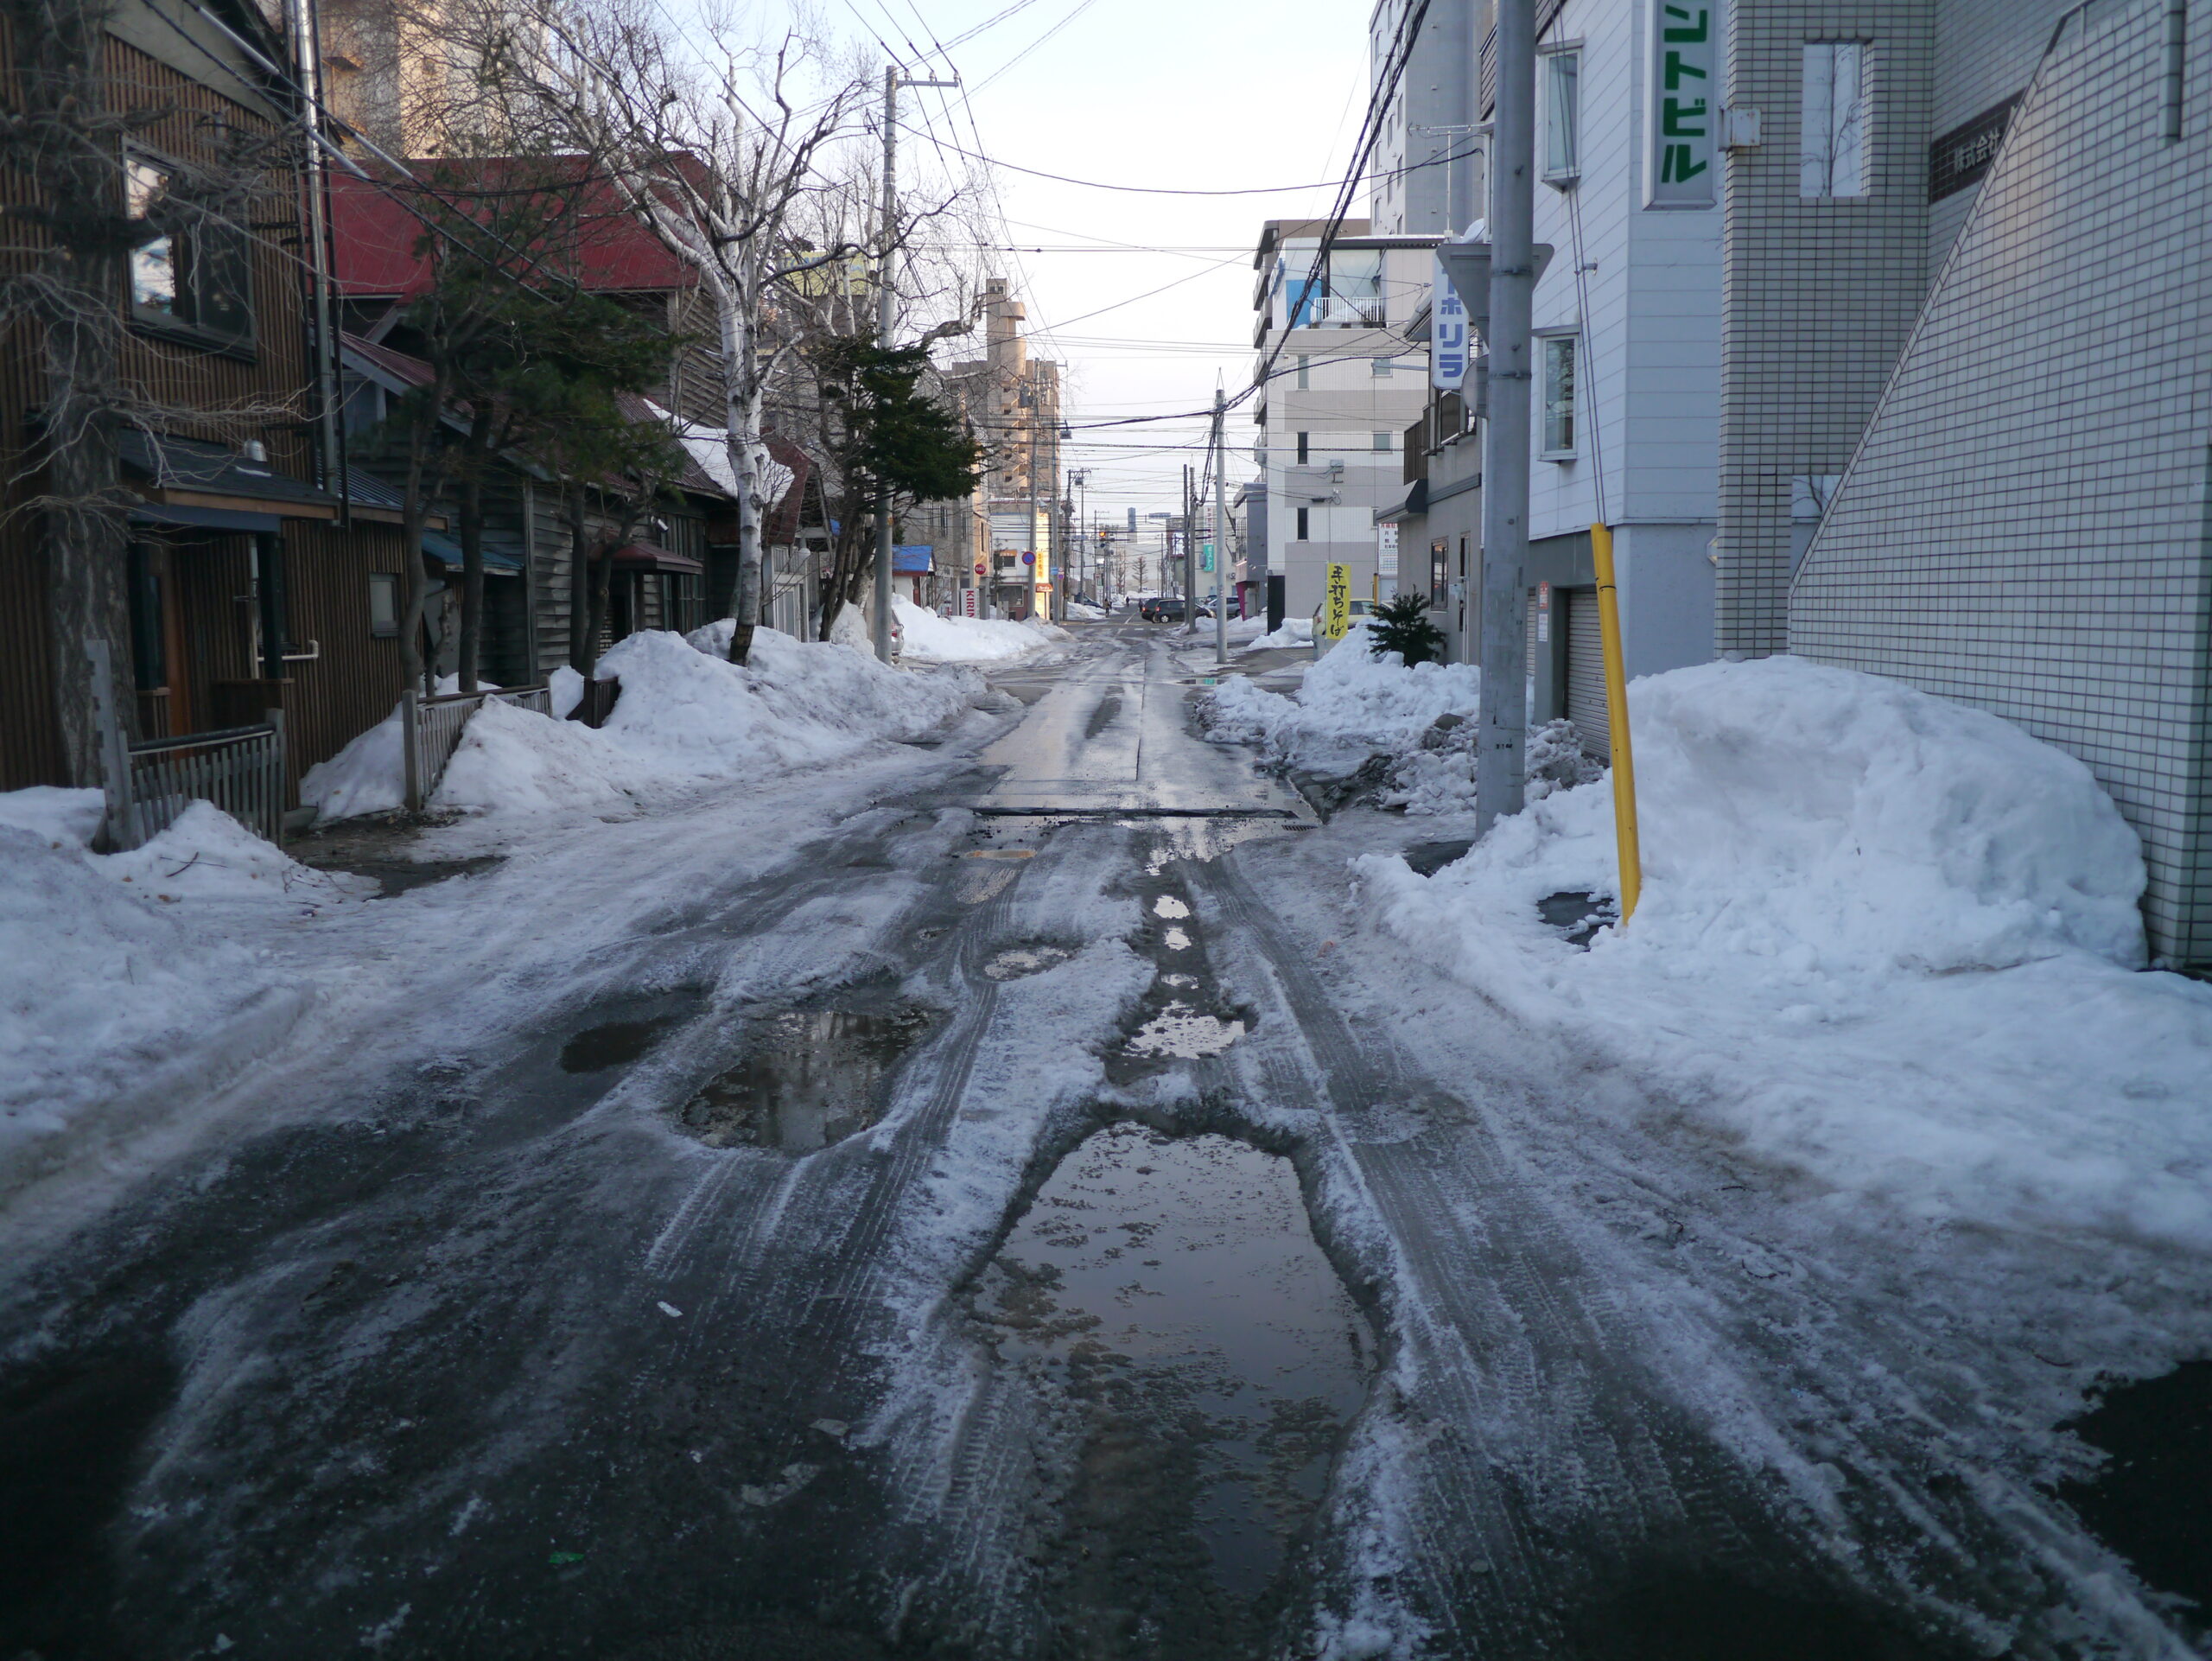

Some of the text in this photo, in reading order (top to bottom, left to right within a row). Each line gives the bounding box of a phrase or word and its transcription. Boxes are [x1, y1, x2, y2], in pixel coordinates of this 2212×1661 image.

[1328, 565, 1346, 636] 手打ちそば
